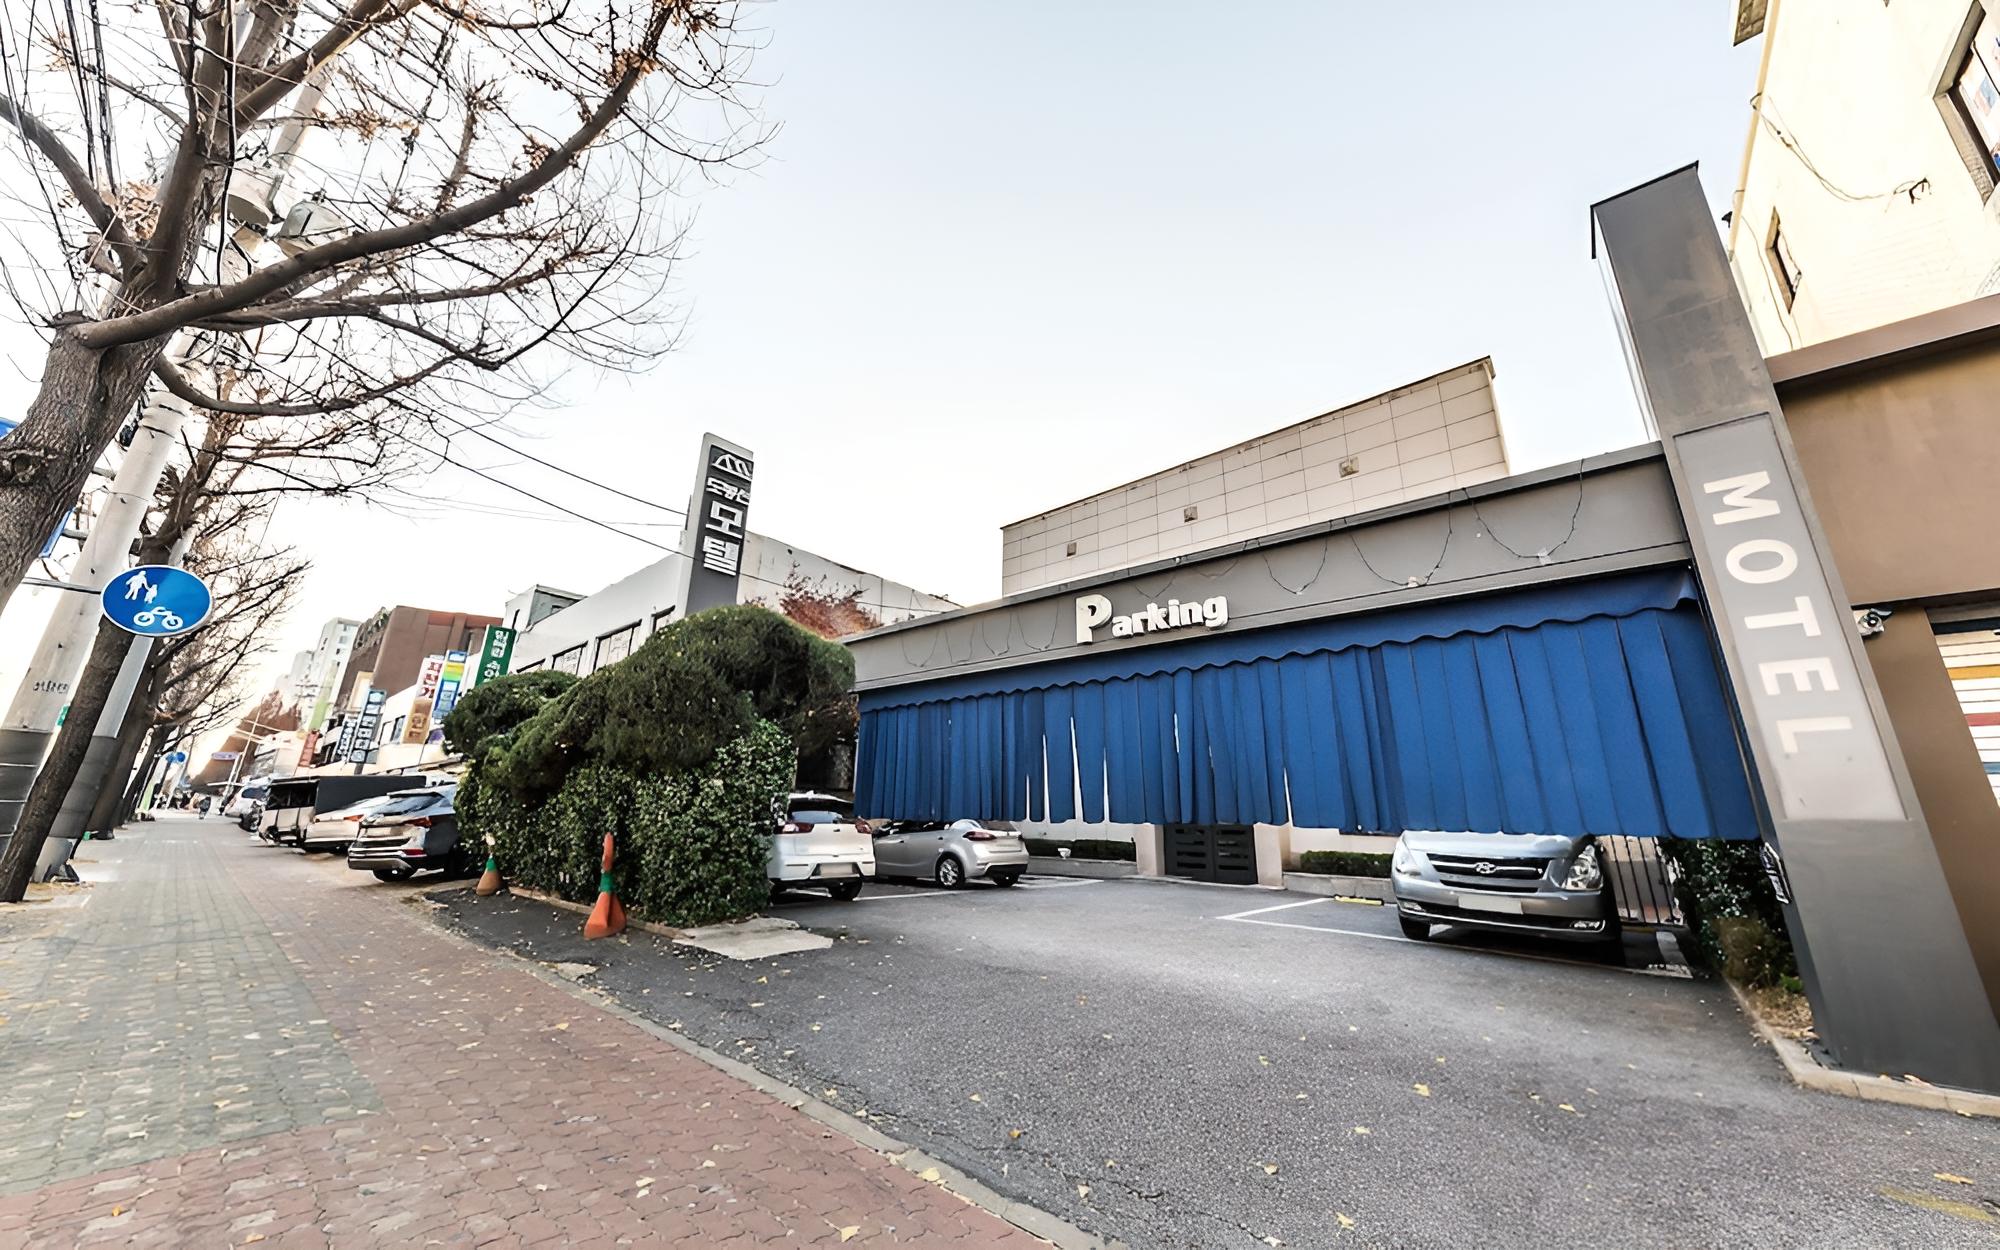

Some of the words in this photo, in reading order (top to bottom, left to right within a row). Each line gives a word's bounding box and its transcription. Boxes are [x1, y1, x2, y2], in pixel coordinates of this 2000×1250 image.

[703, 500, 743, 577] 모텔
[1075, 594, 1229, 643] Parking
[1703, 470, 1852, 753] MOTEL
